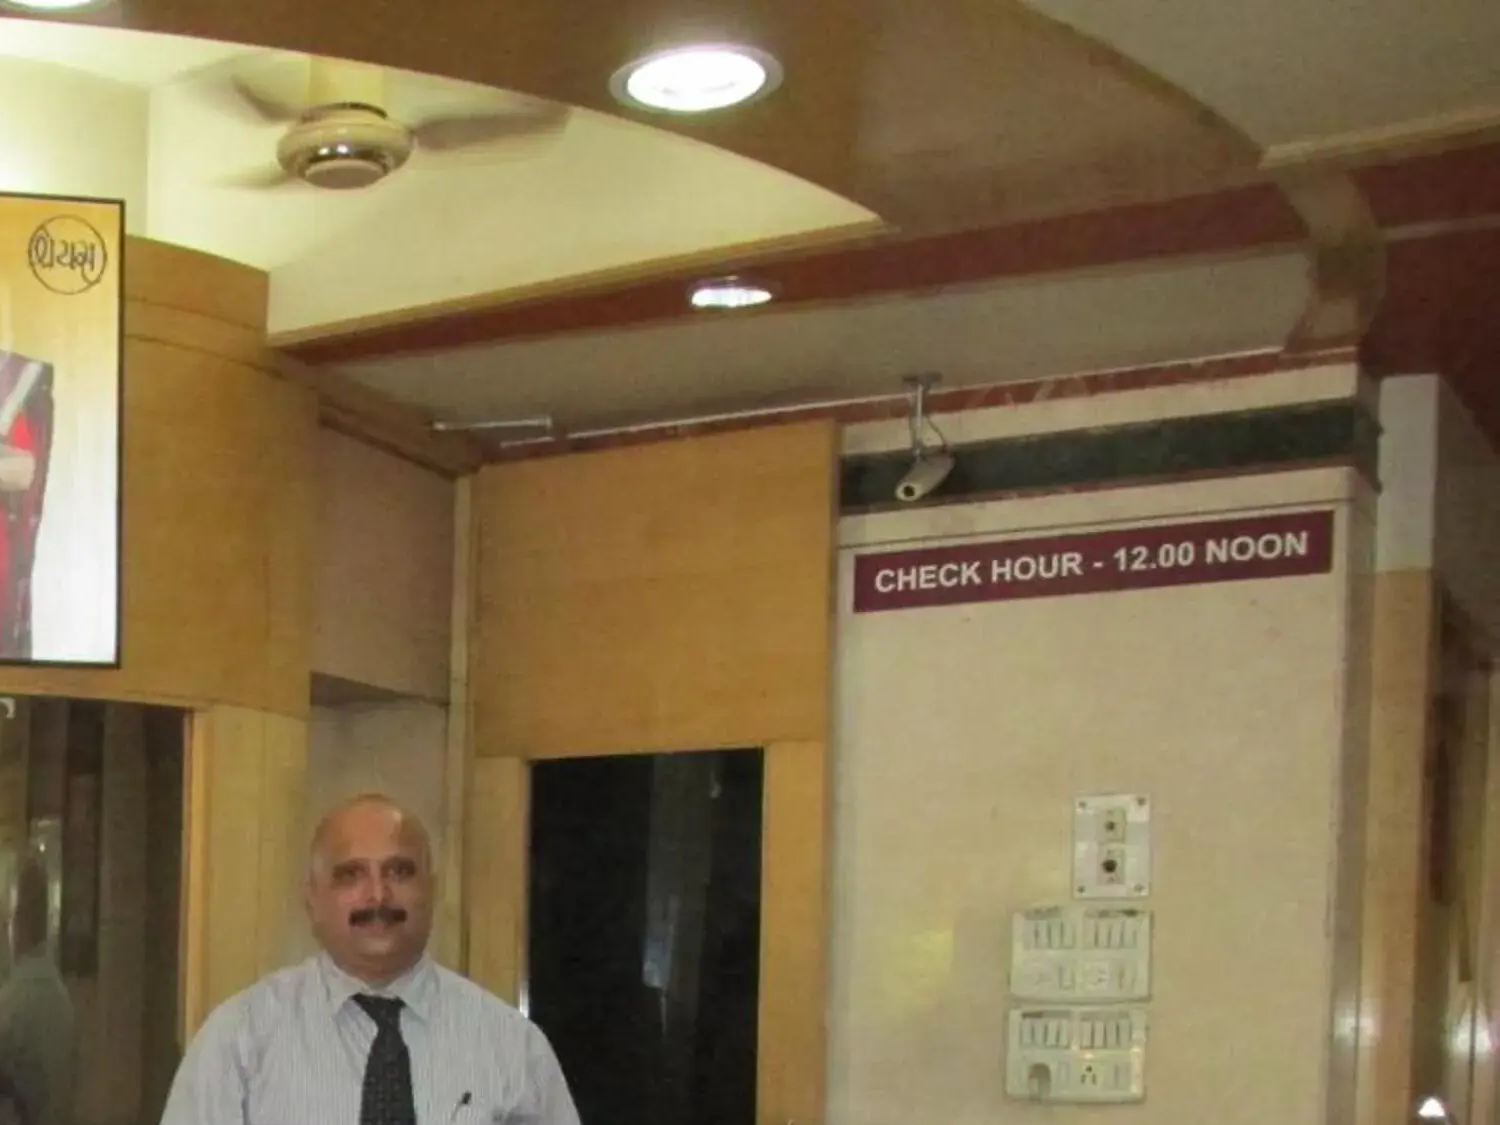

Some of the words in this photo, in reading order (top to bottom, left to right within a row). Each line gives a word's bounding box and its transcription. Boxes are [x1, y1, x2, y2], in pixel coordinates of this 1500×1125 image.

[875, 560, 981, 593] CHECK
[991, 551, 1083, 583] HOUR
[1114, 541, 1195, 571] 12.00
[1205, 531, 1309, 564] NOON
